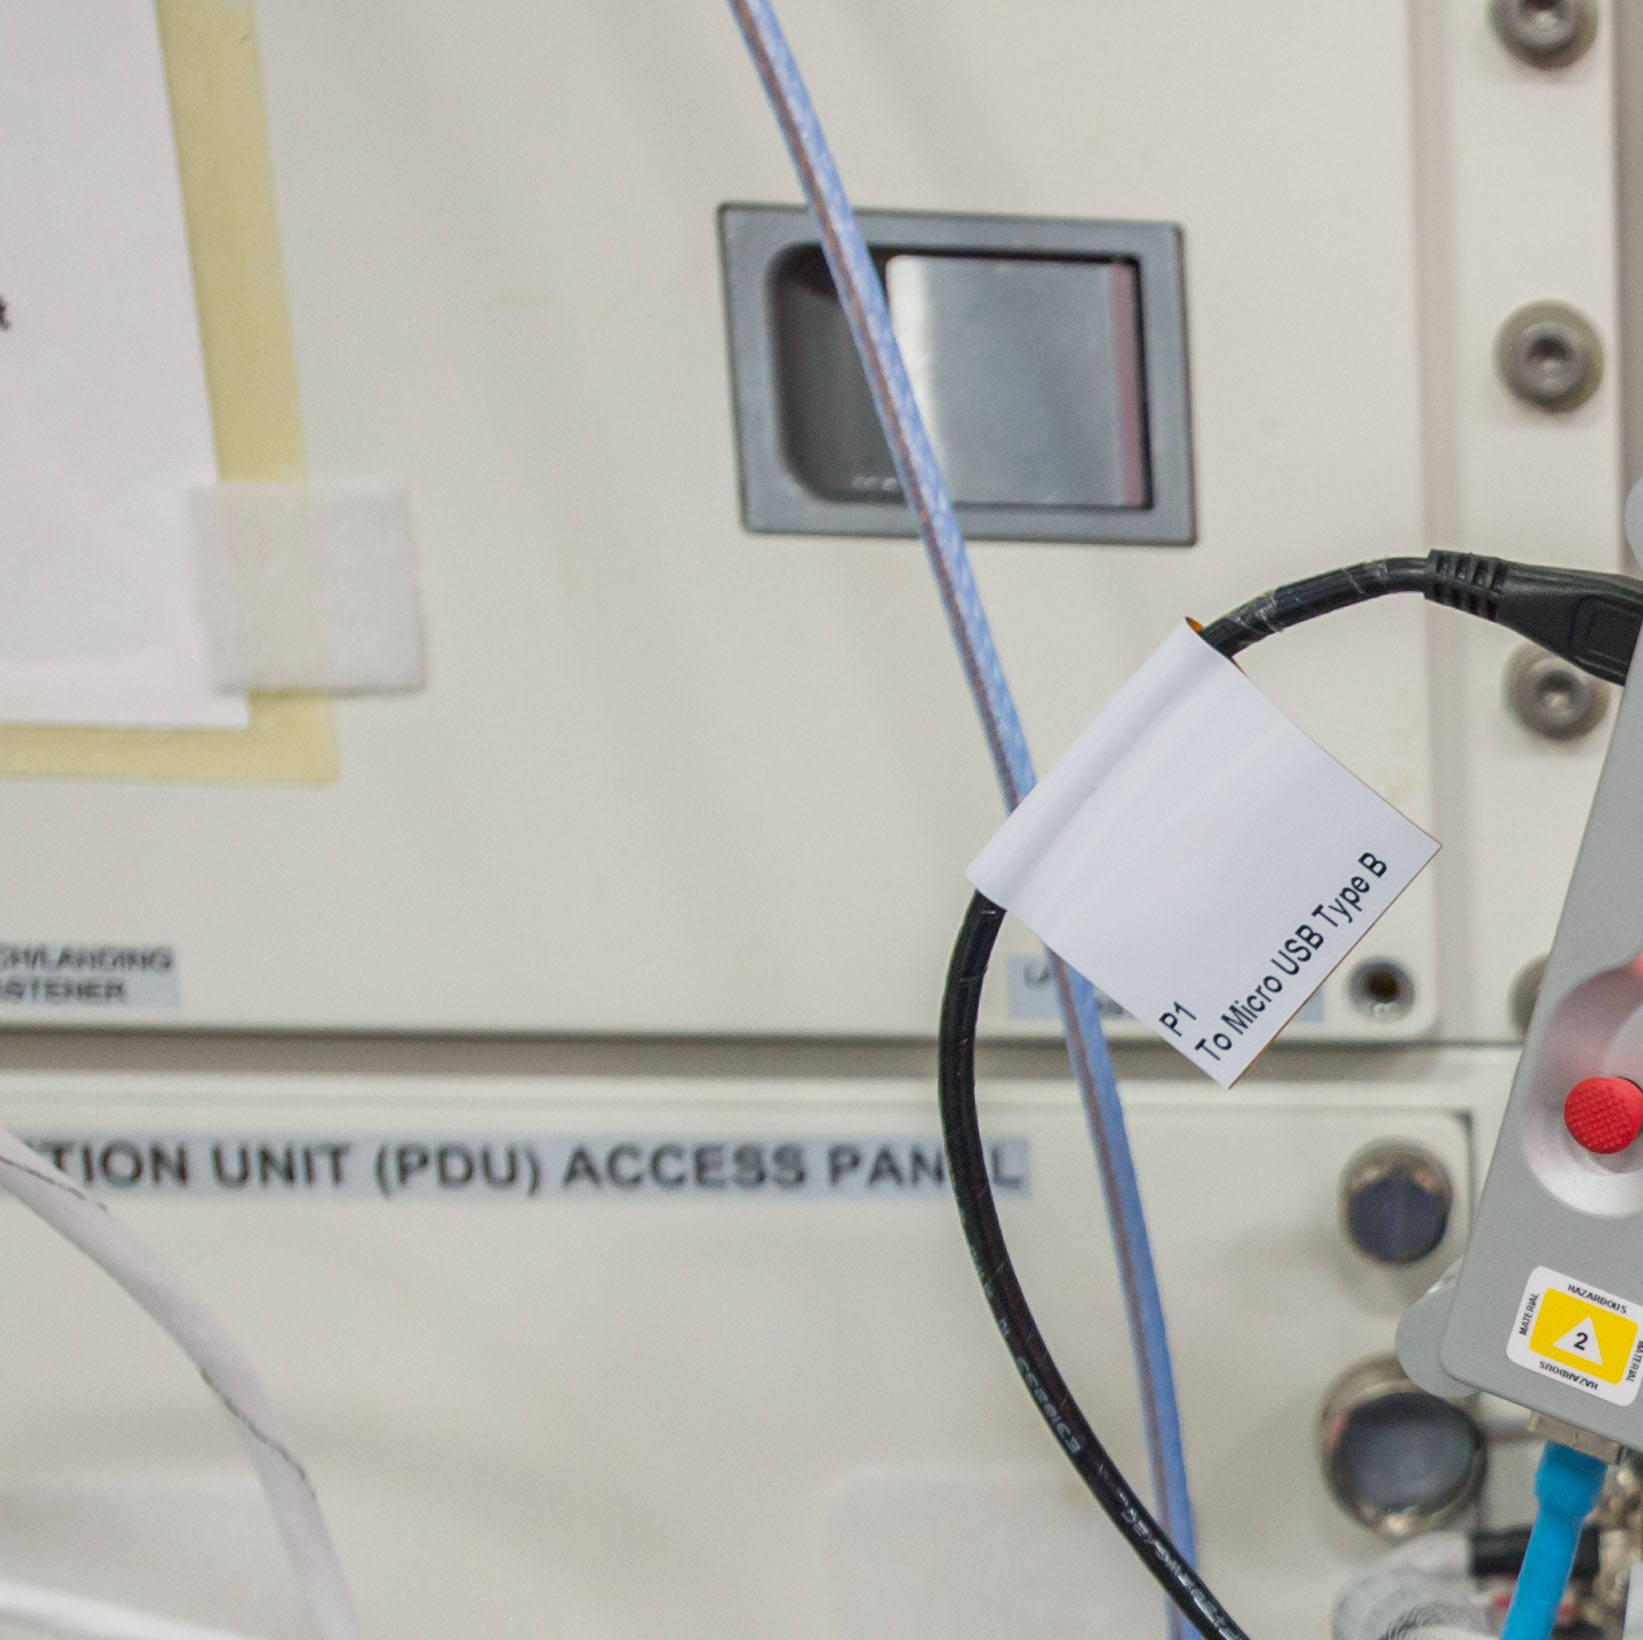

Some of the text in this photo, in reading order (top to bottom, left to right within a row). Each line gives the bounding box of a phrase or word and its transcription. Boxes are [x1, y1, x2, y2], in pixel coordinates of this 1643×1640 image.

[1194, 850, 1390, 1063] To Micro USB Type B
[1159, 1000, 1199, 1038] P1
[211, 1141, 350, 1189] UNIT
[374, 1142, 541, 1197] (PDU)
[562, 1145, 807, 1191] ACCESS
[828, 1146, 1024, 1190] PANL
[1518, 1293, 1541, 1337] MATERIAL
[1567, 1283, 1629, 1315] HAZARDOUS
[1573, 1331, 1590, 1352] 2
[1538, 1360, 1600, 1391] HAZARDOUS
